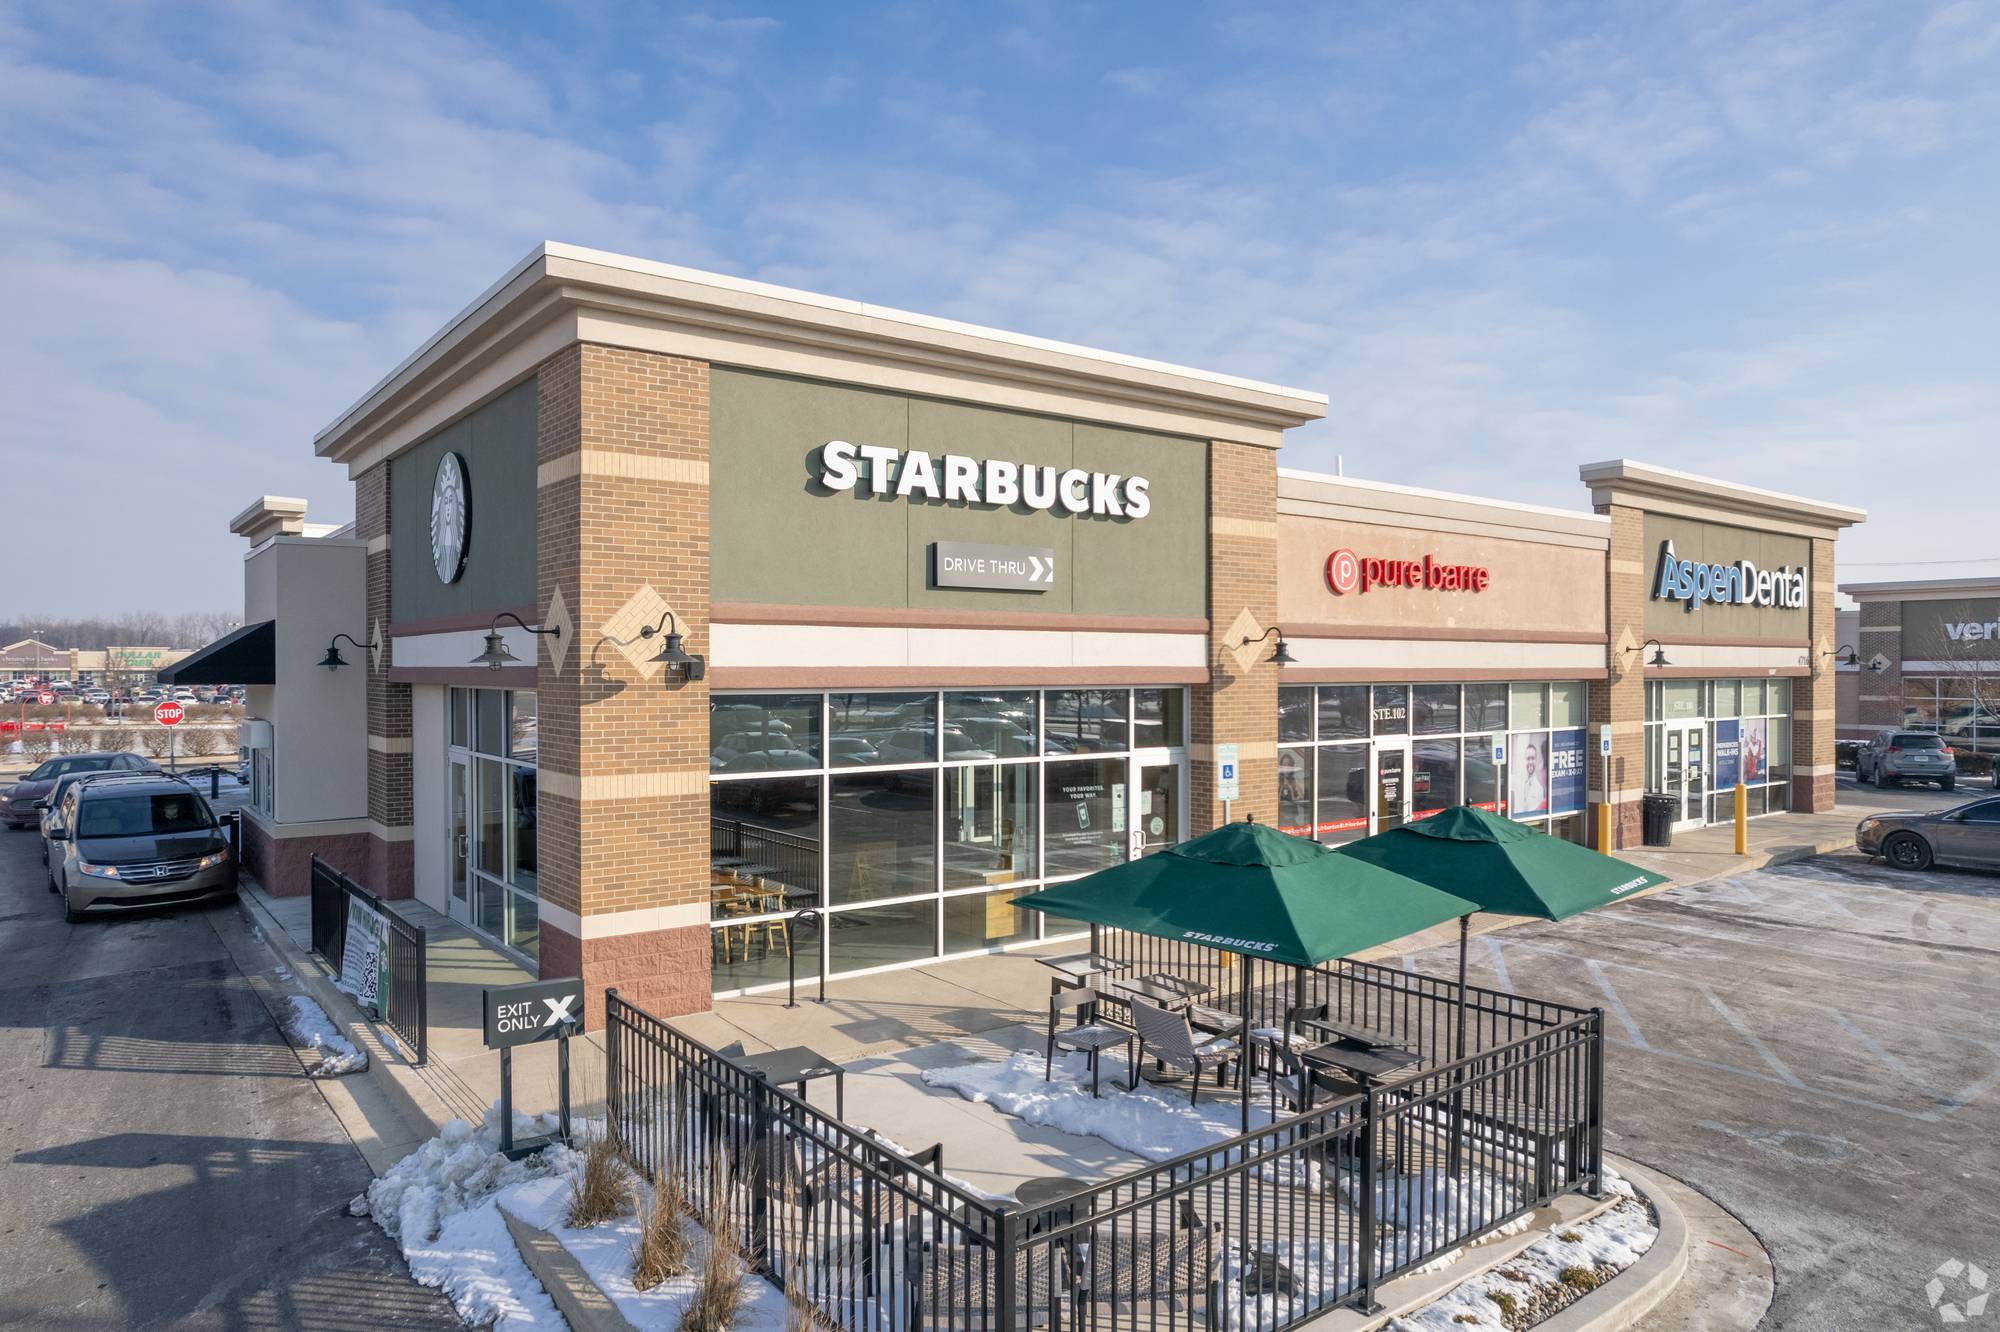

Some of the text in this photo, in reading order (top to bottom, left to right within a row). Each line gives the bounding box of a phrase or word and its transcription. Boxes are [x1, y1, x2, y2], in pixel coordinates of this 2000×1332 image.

[821, 440, 1151, 519] STARBUCKS
[943, 557, 1026, 575] DRIVE THRU
[1363, 553, 1489, 592] pure barre
[156, 707, 182, 719] STOP
[1551, 749, 1584, 769] FREE
[1551, 769, 1565, 778] EXAM
[1610, 875, 1649, 895] STARBUCKS
[1183, 931, 1275, 952] STARBUCKS
[497, 1001, 532, 1019] EXIT
[497, 1014, 540, 1033] ONLY
